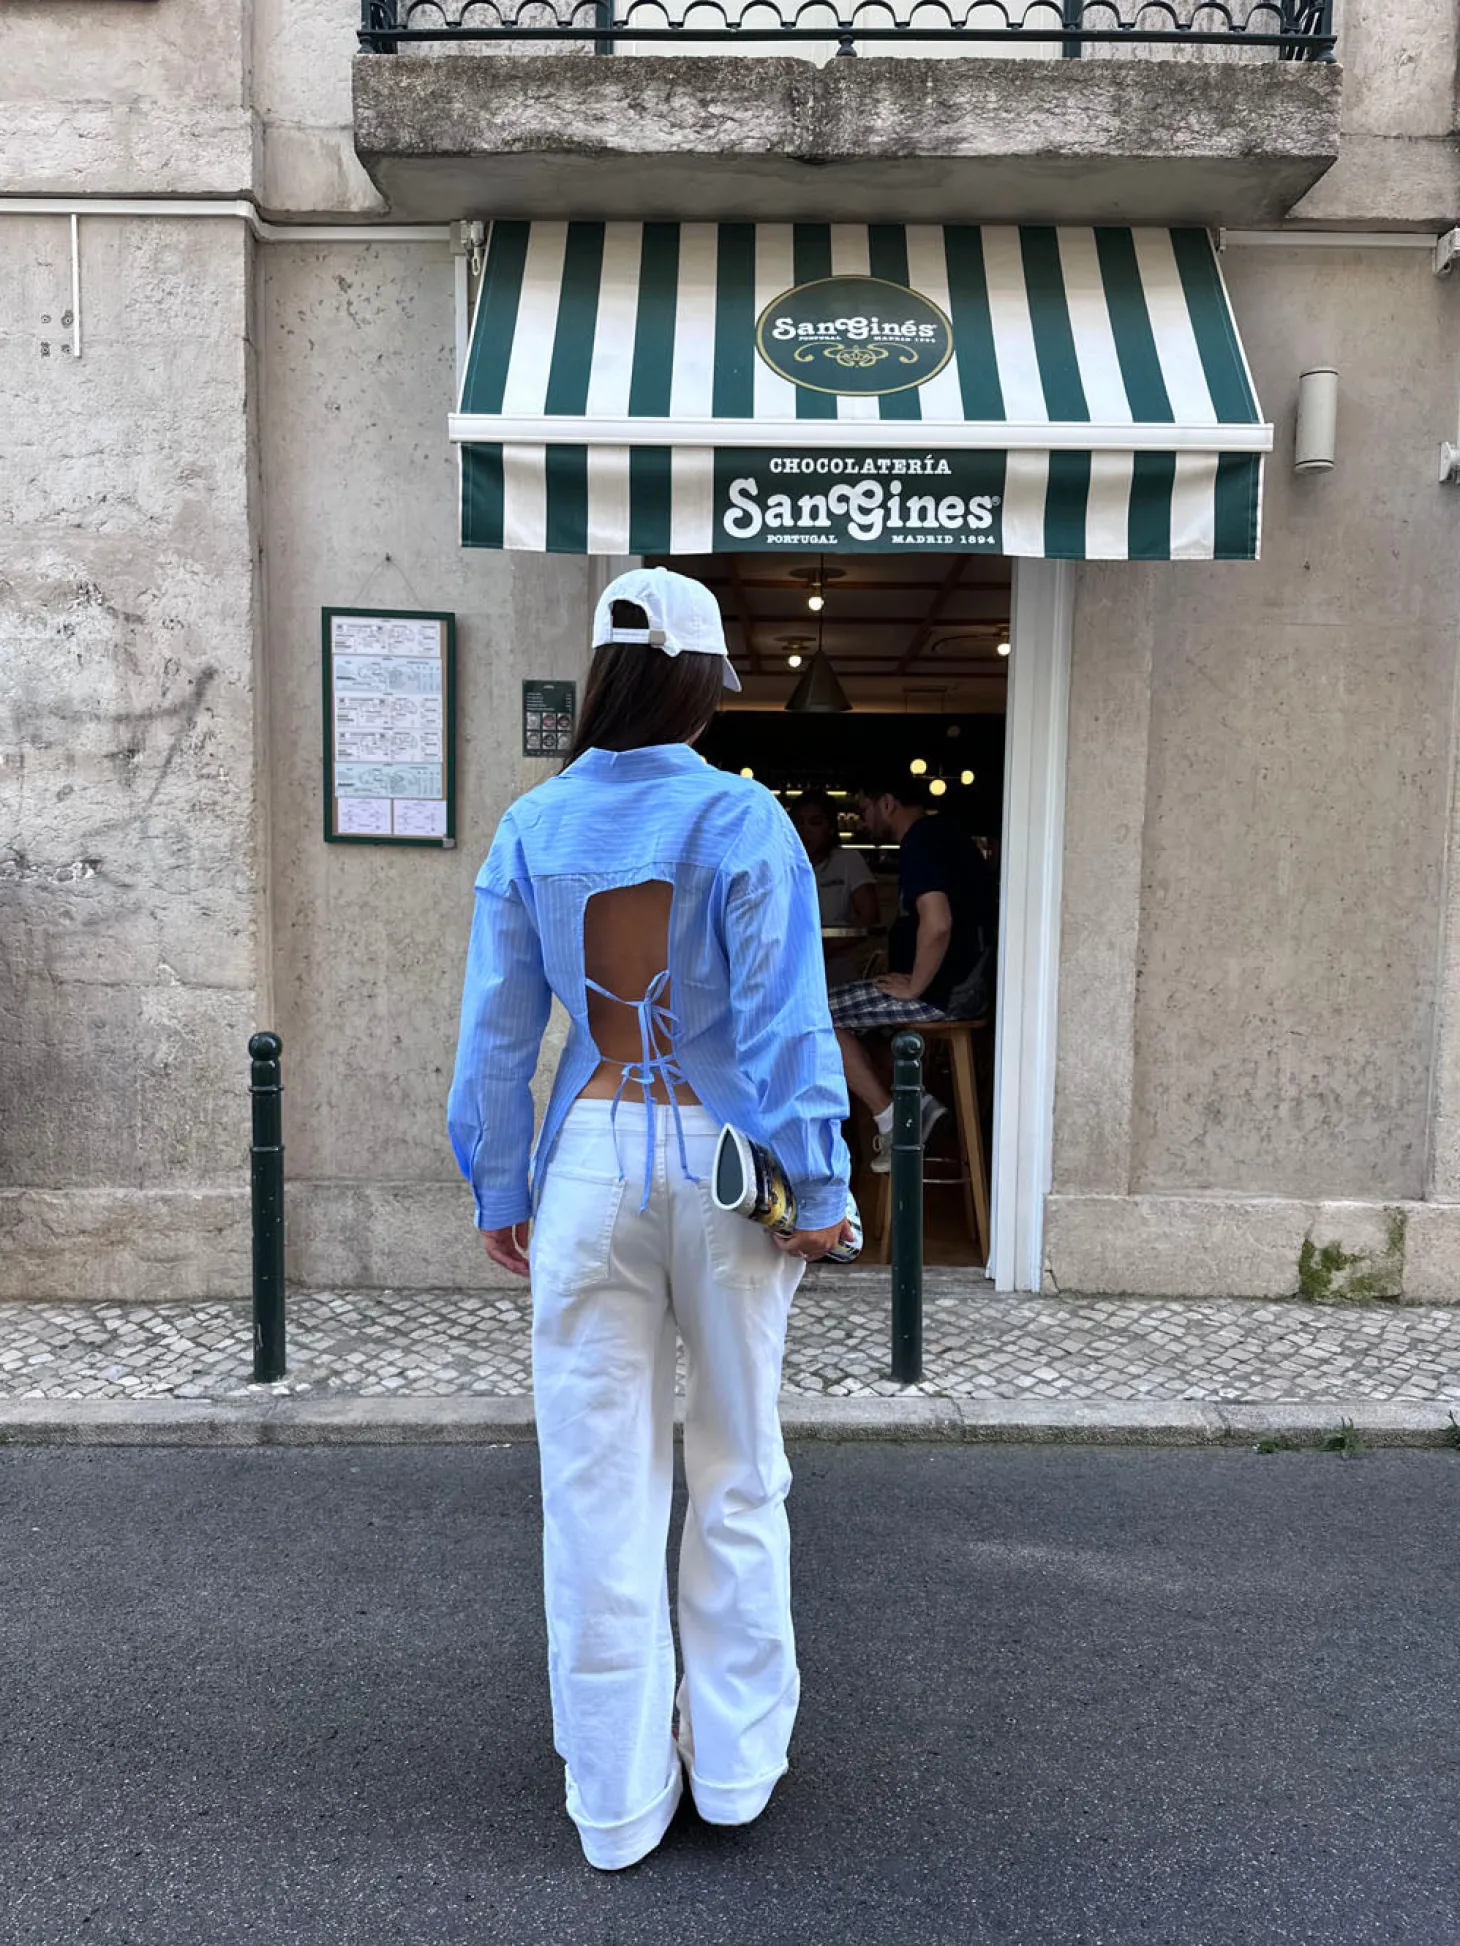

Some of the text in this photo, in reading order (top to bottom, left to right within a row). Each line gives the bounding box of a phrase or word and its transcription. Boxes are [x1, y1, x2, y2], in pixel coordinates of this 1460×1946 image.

[770, 454, 952, 475] CHOCOLATERÍA
[766, 534, 996, 544] PORTUGAL MADRID 1894
